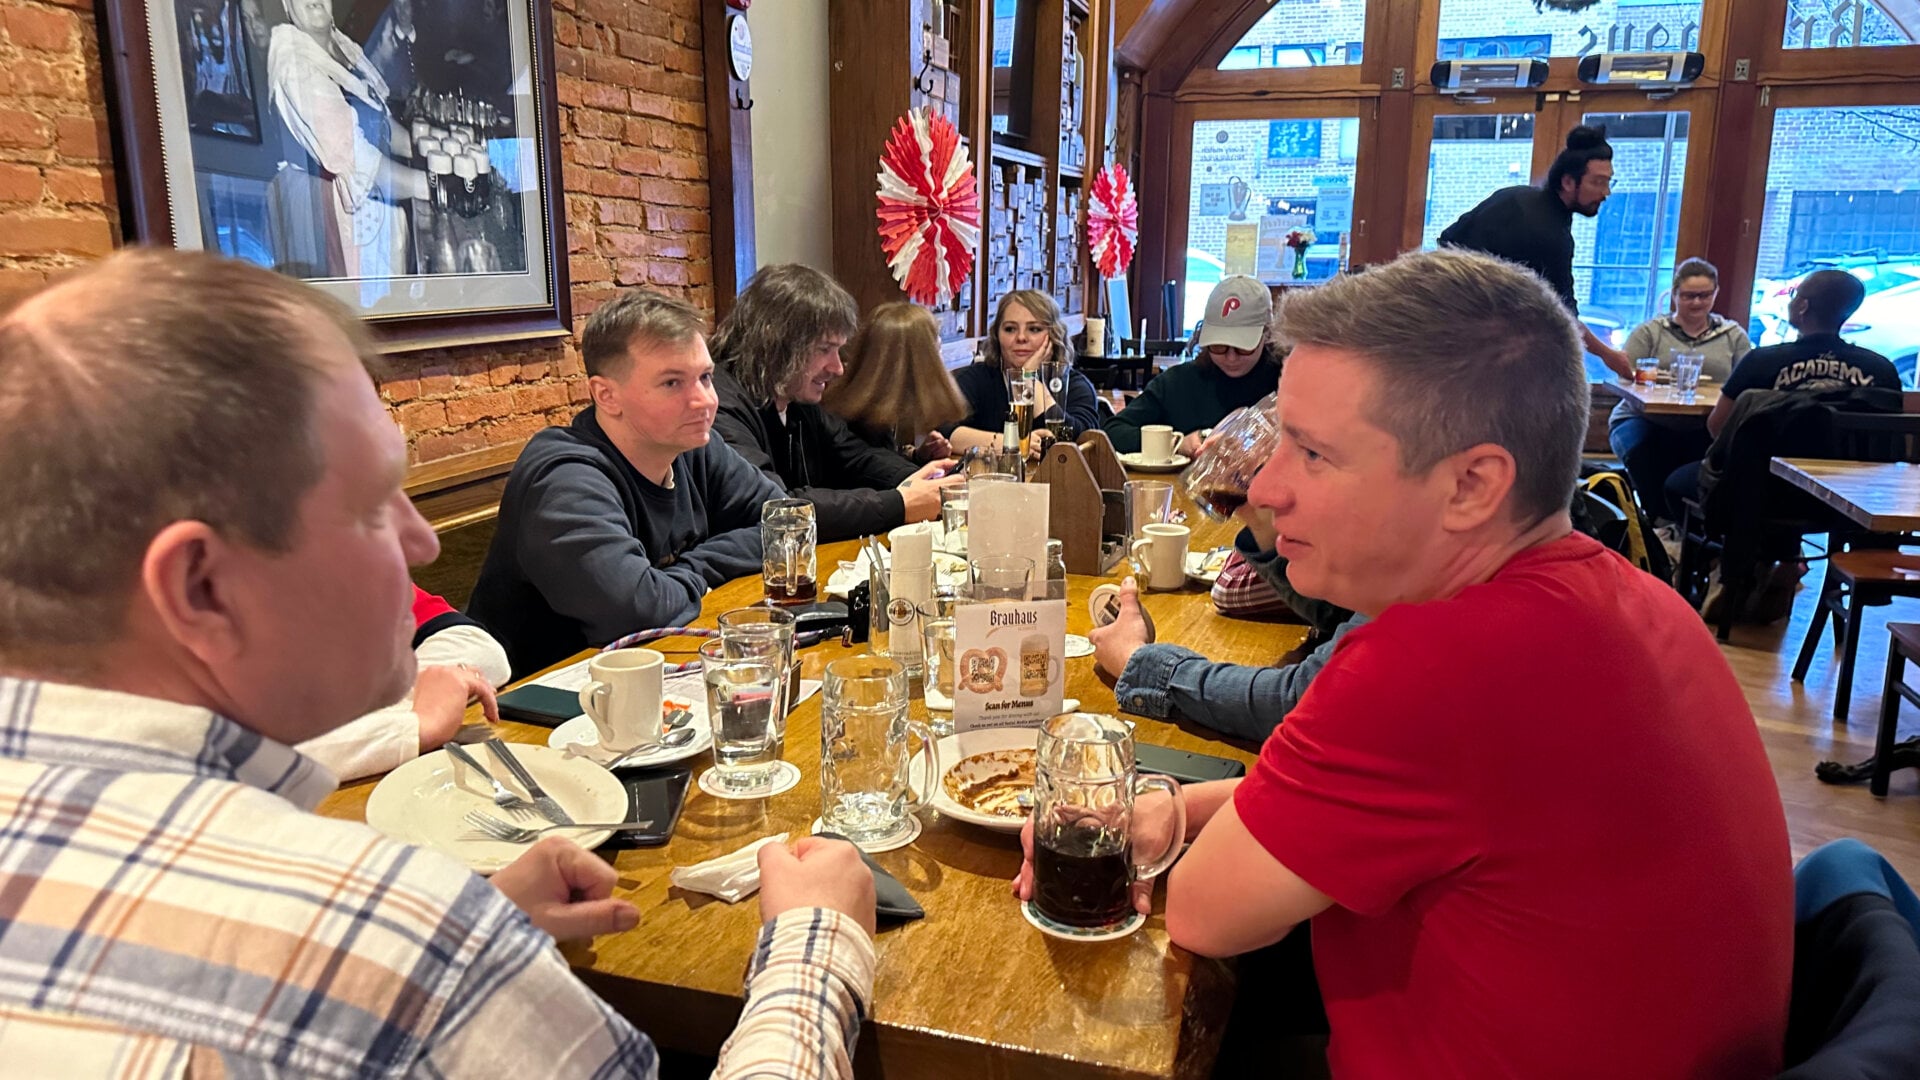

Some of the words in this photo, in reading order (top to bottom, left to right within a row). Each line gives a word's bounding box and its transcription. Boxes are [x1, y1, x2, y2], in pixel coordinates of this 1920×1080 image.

[1773, 359, 1875, 390] ACADEMY
[990, 609, 1038, 626] Brauhaus
[984, 702, 1000, 711] Scan
[1001, 700, 1011, 710] for
[1011, 699, 1034, 709] Menus
